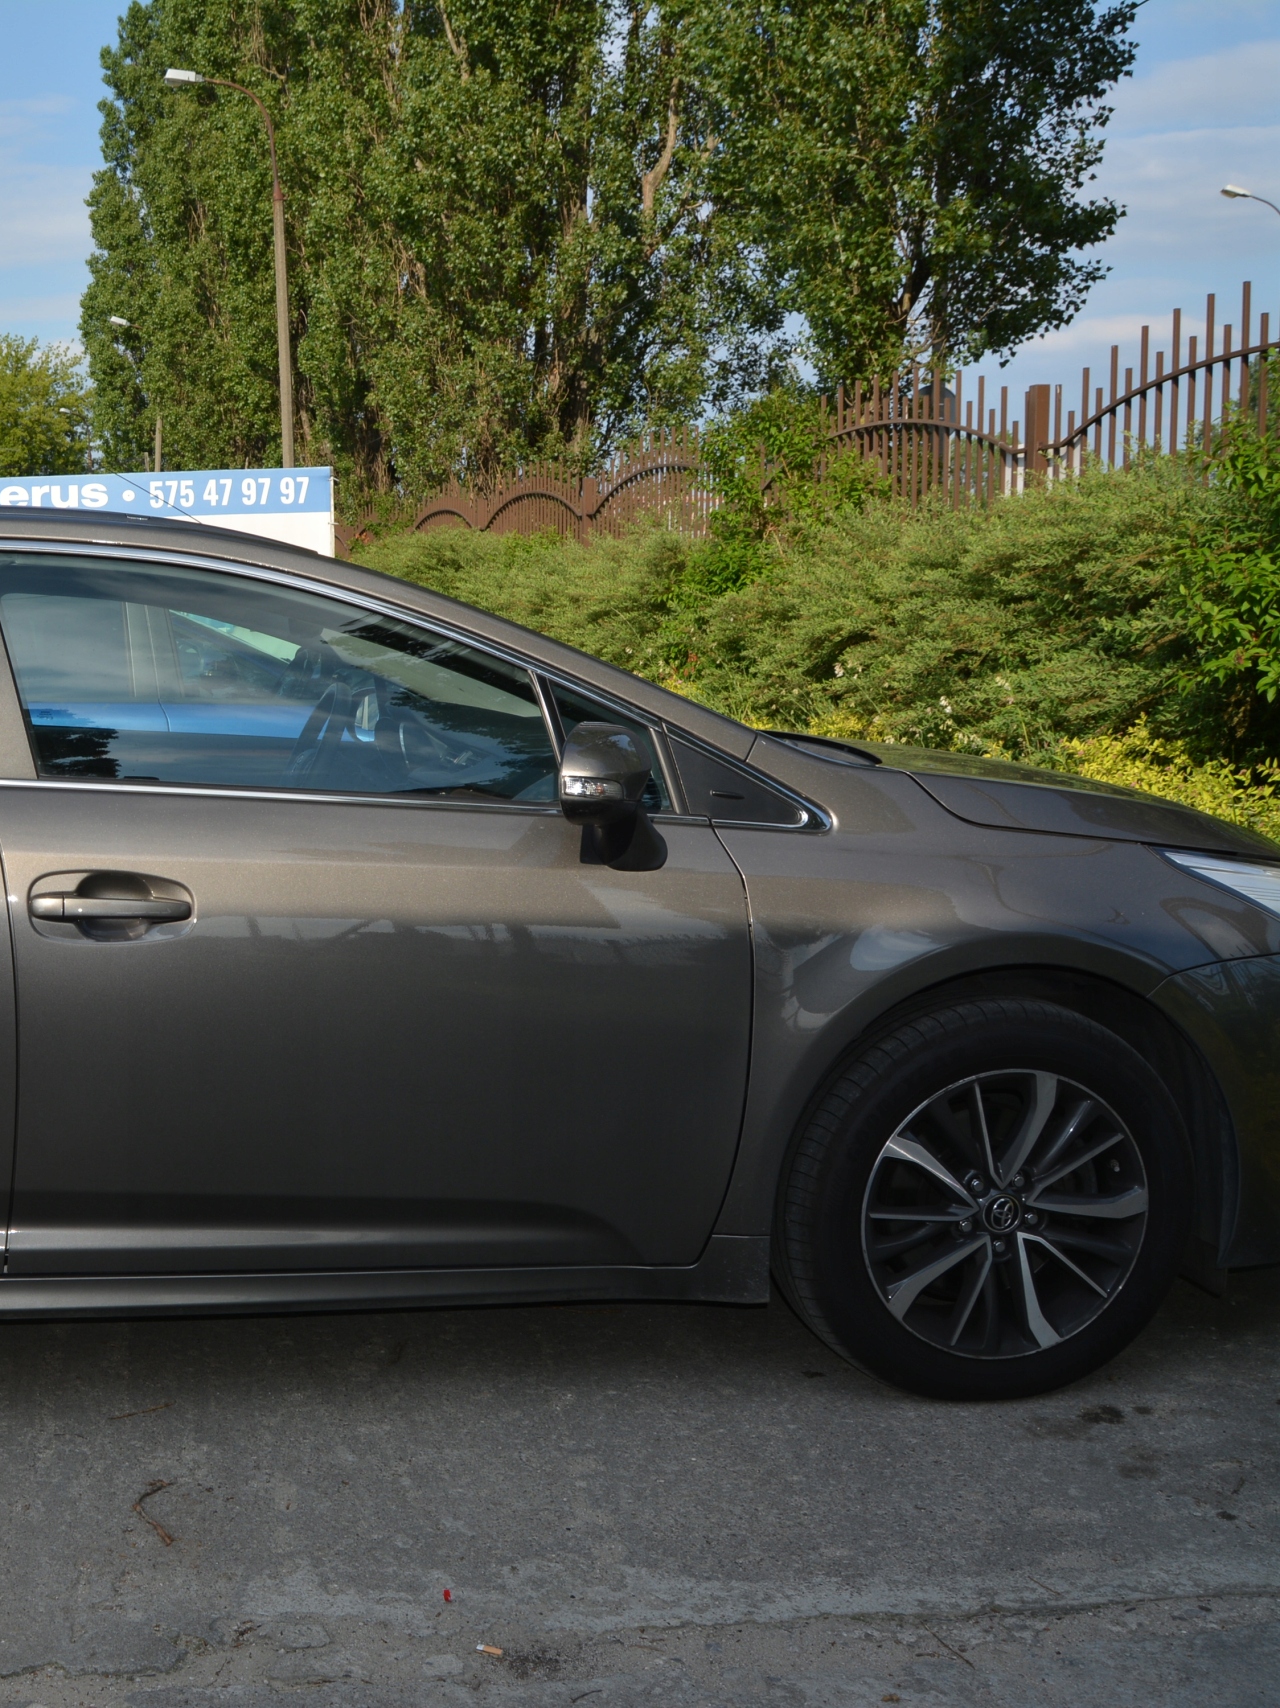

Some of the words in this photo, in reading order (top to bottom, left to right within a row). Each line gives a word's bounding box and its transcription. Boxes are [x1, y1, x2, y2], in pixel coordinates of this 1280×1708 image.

[149, 480, 195, 508] 575
[203, 478, 233, 506] 47
[241, 477, 271, 506] 97
[279, 476, 310, 504] 97
